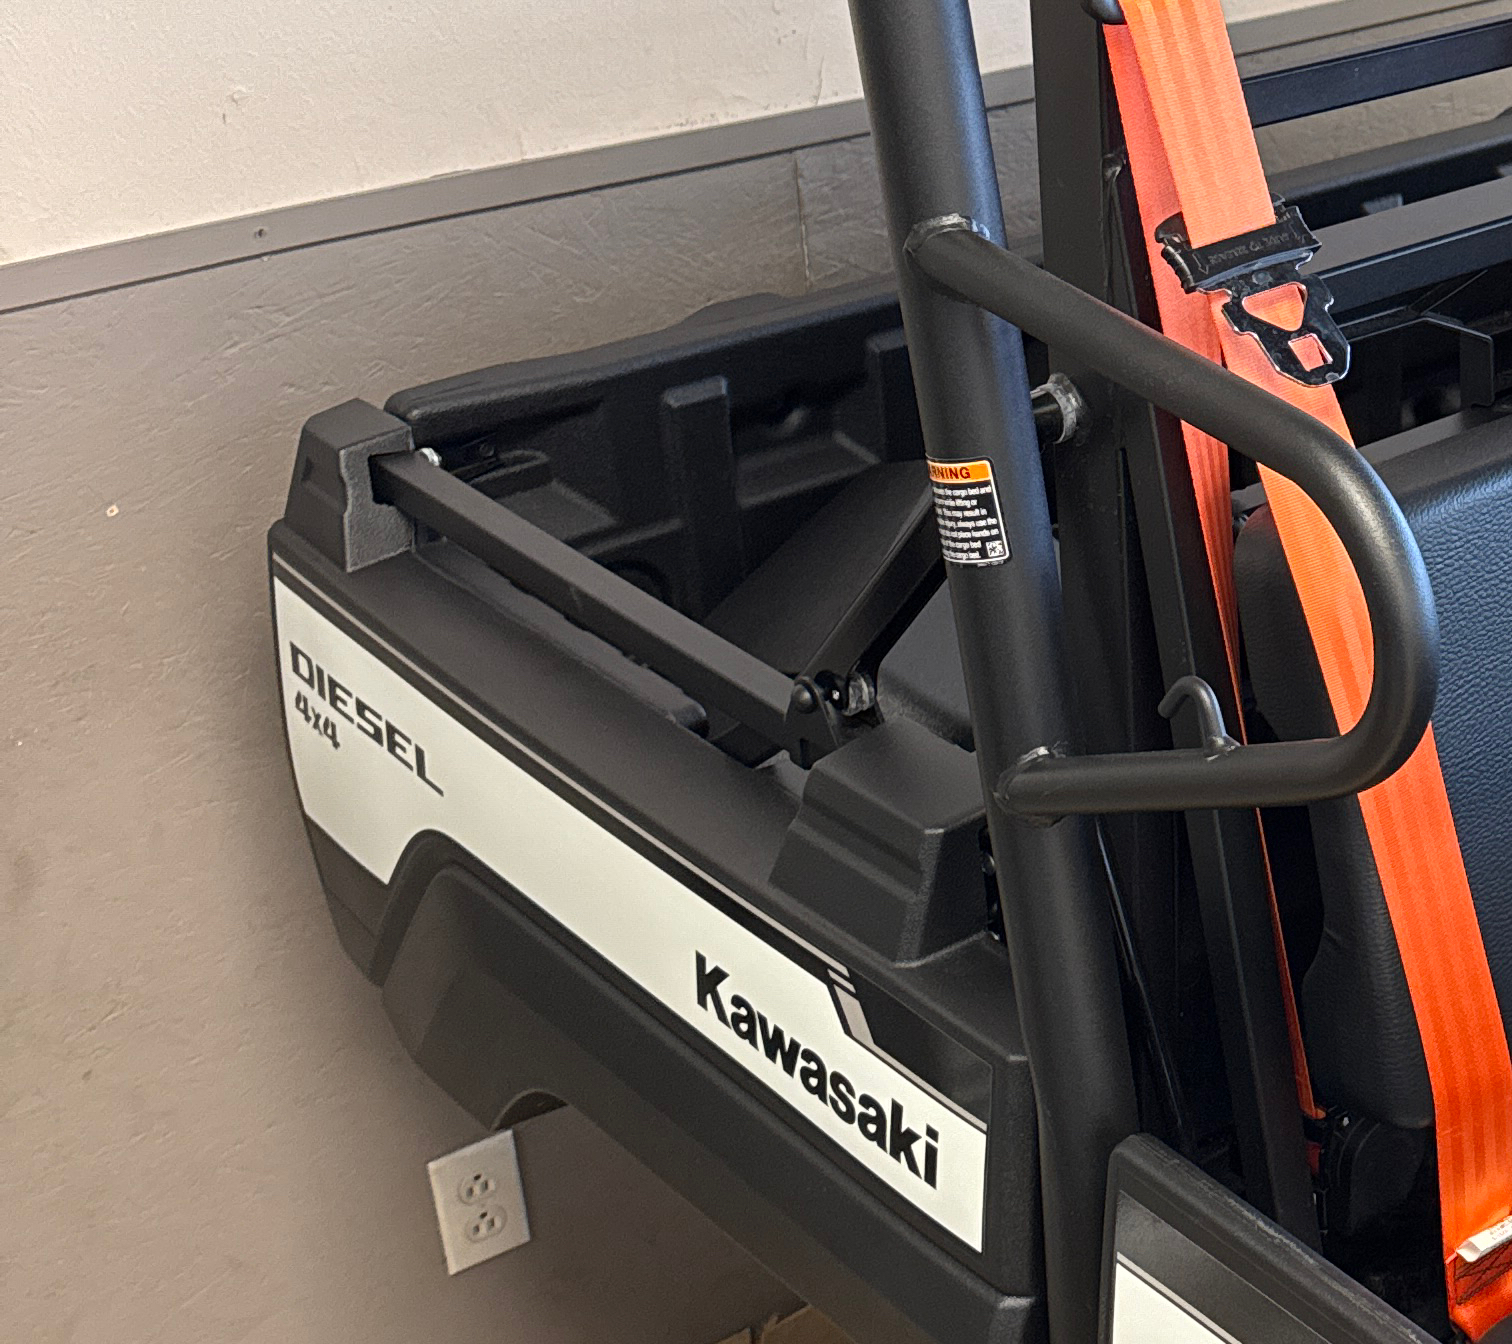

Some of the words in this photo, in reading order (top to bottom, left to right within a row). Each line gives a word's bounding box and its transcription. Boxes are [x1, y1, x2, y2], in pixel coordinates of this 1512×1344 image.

[929, 466, 971, 480] RNING
[289, 640, 444, 797] DIESEL
[696, 950, 939, 1190] Kawasaki
